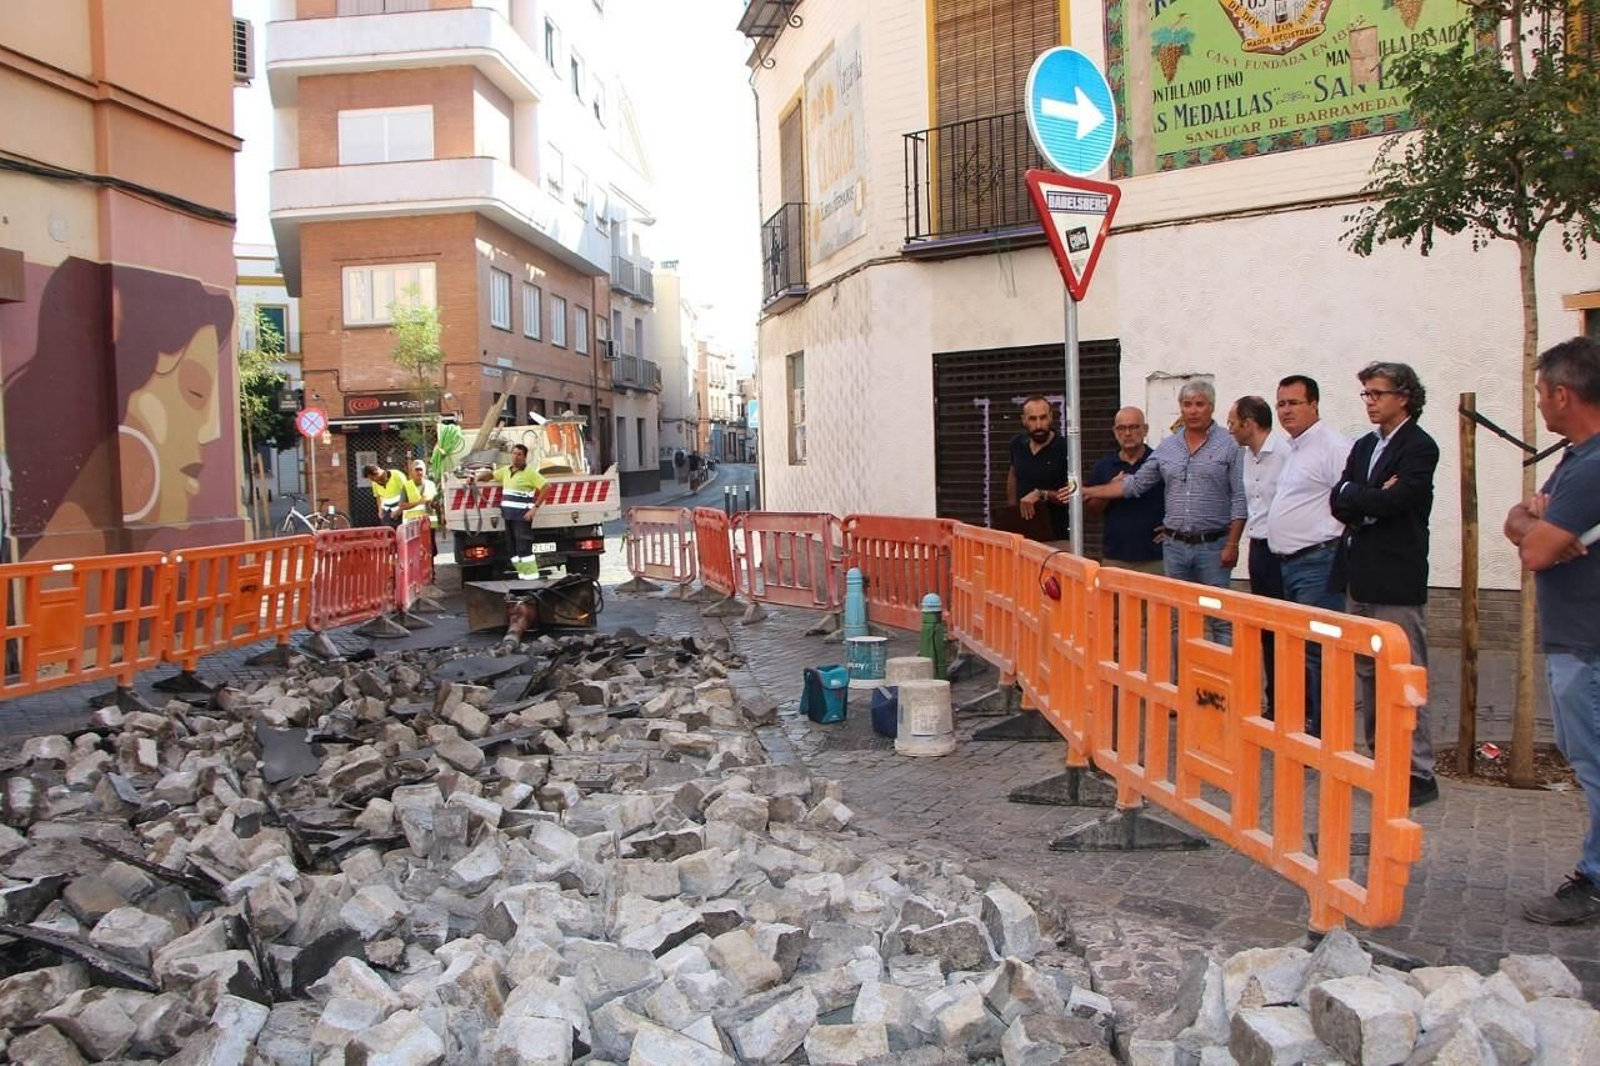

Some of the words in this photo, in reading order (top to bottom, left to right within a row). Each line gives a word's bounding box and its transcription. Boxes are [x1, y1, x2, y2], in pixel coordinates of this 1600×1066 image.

[1246, 37, 1271, 47] MARCA
[1274, 26, 1320, 42] REGISTRADA
[1245, 52, 1307, 70] FUNDADA
[1312, 41, 1328, 57] EN
[1216, 71, 1243, 91] FINO
[1185, 121, 1261, 144] SANLUCAR
[1269, 116, 1289, 130] DE
[1295, 96, 1401, 125] BARRAMEDA
